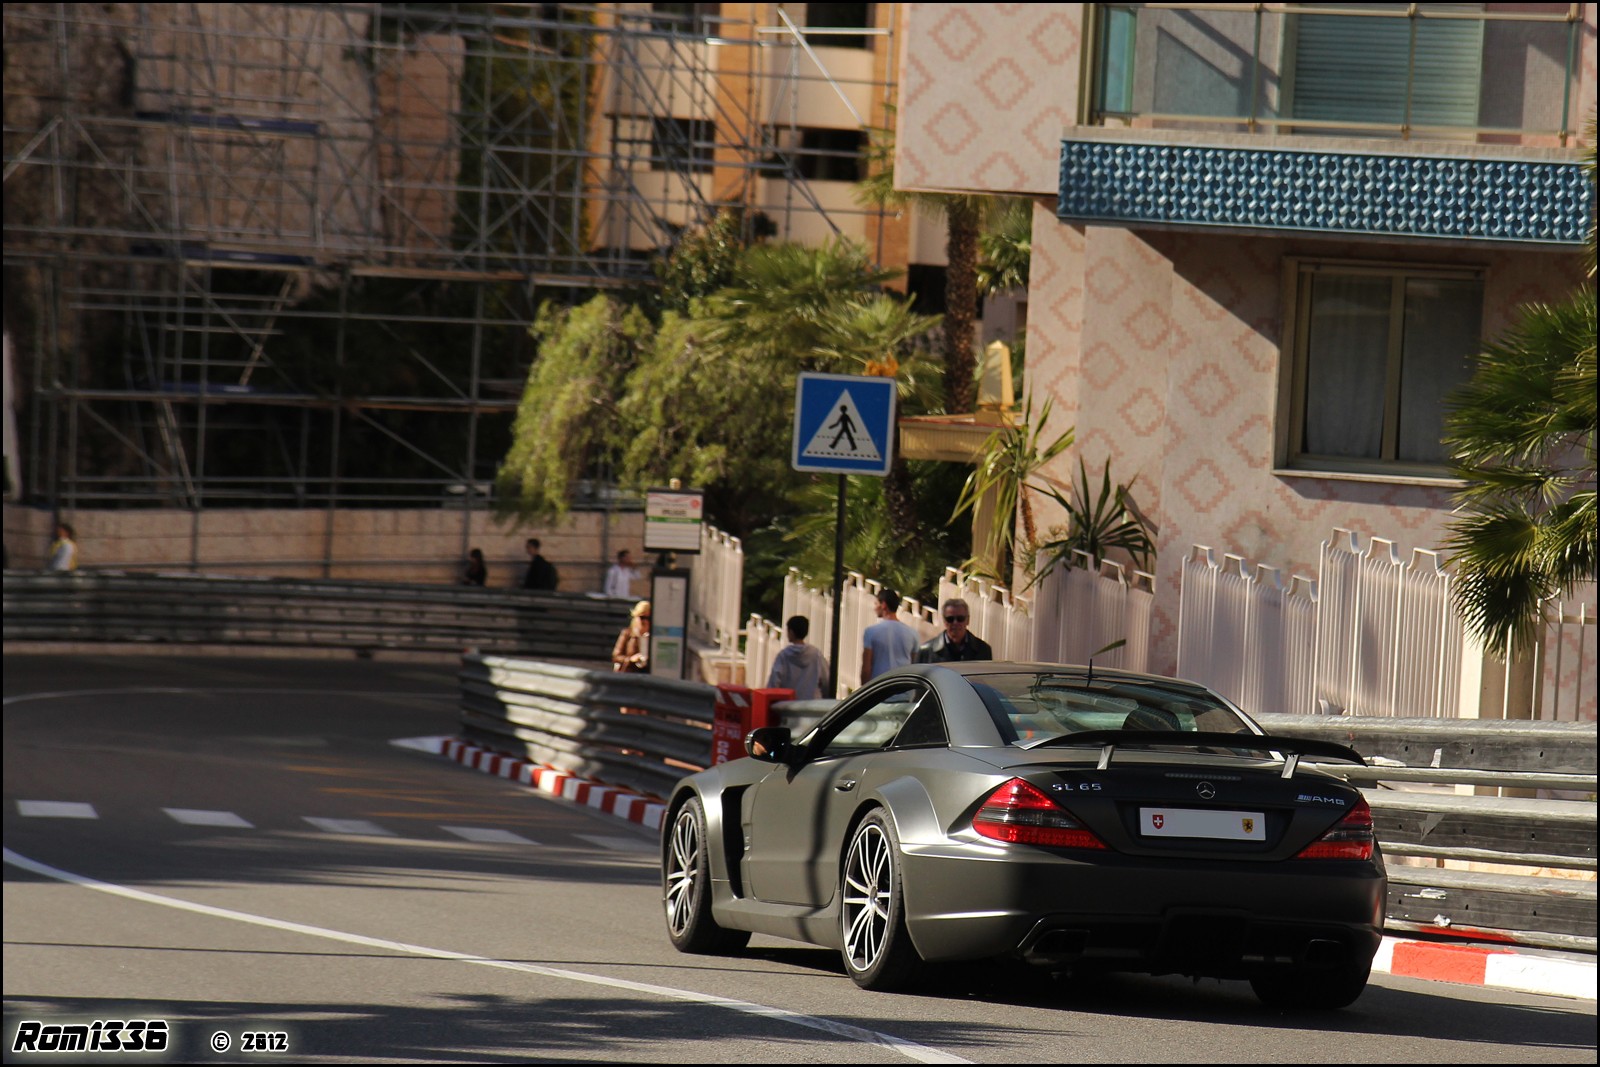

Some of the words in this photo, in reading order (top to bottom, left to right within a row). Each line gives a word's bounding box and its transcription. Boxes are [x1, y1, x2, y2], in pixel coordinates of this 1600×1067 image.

[1052, 783, 1074, 791] SL
[1079, 783, 1102, 791] 65
[1311, 795, 1345, 806] AMG
